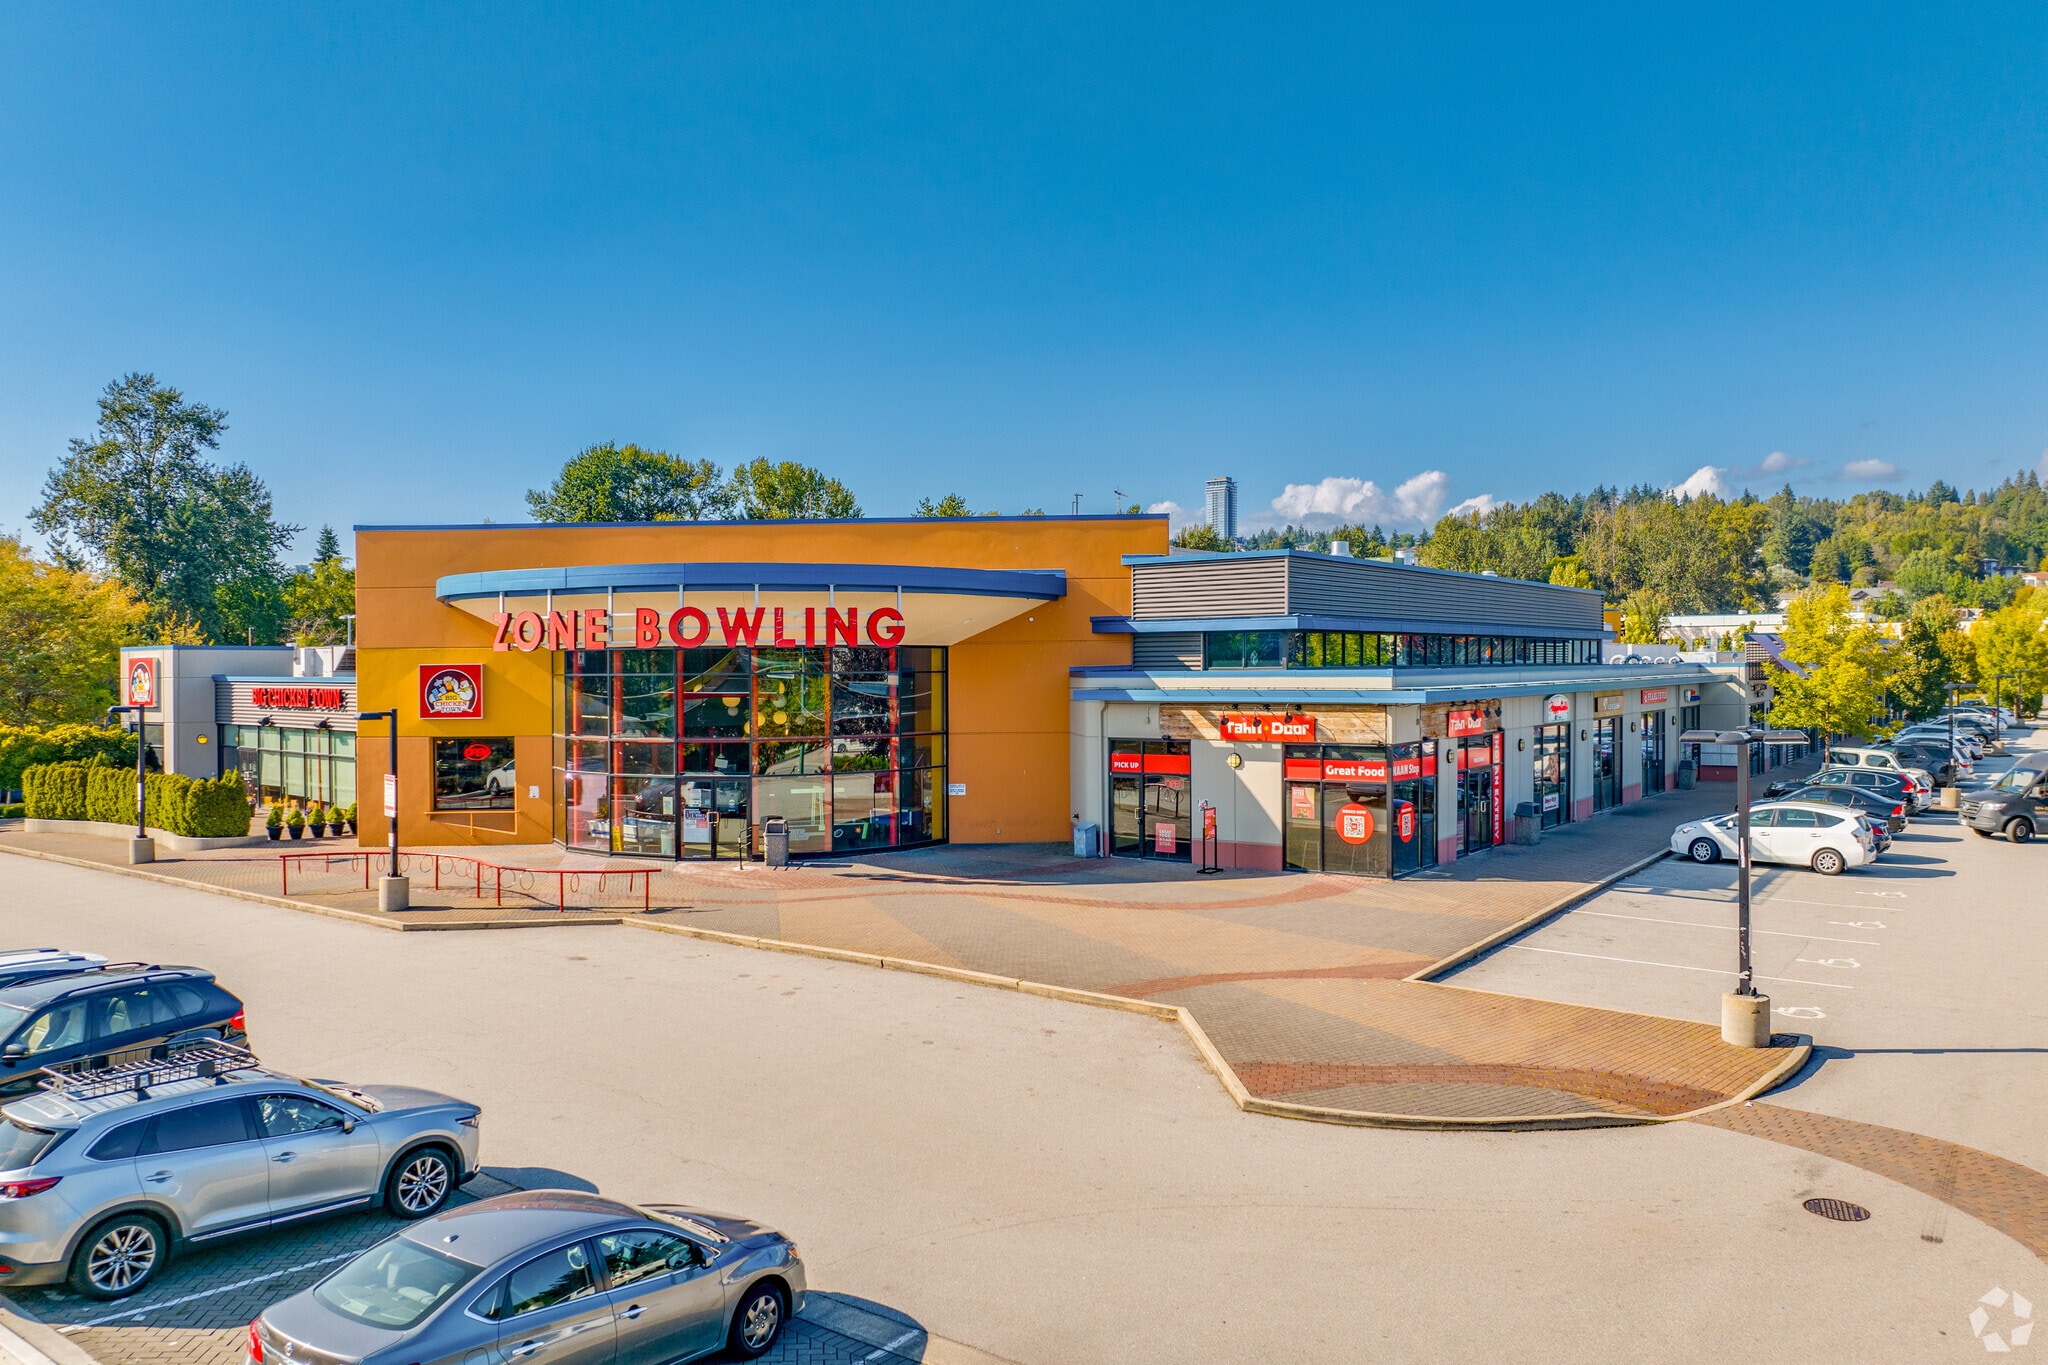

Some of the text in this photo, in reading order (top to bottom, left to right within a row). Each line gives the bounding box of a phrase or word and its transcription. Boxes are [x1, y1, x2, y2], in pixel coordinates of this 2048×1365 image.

[493, 606, 906, 652] ZONE BOWLING
[252, 688, 340, 708] BIG CHICKEN TOWN
[1227, 721, 1262, 734] Tahn
[1114, 761, 1129, 769] PICK
[1325, 765, 1355, 776] Great
[1358, 765, 1385, 777] Food
[1409, 763, 1420, 776] Stop
[1165, 779, 1184, 788] OPEN
